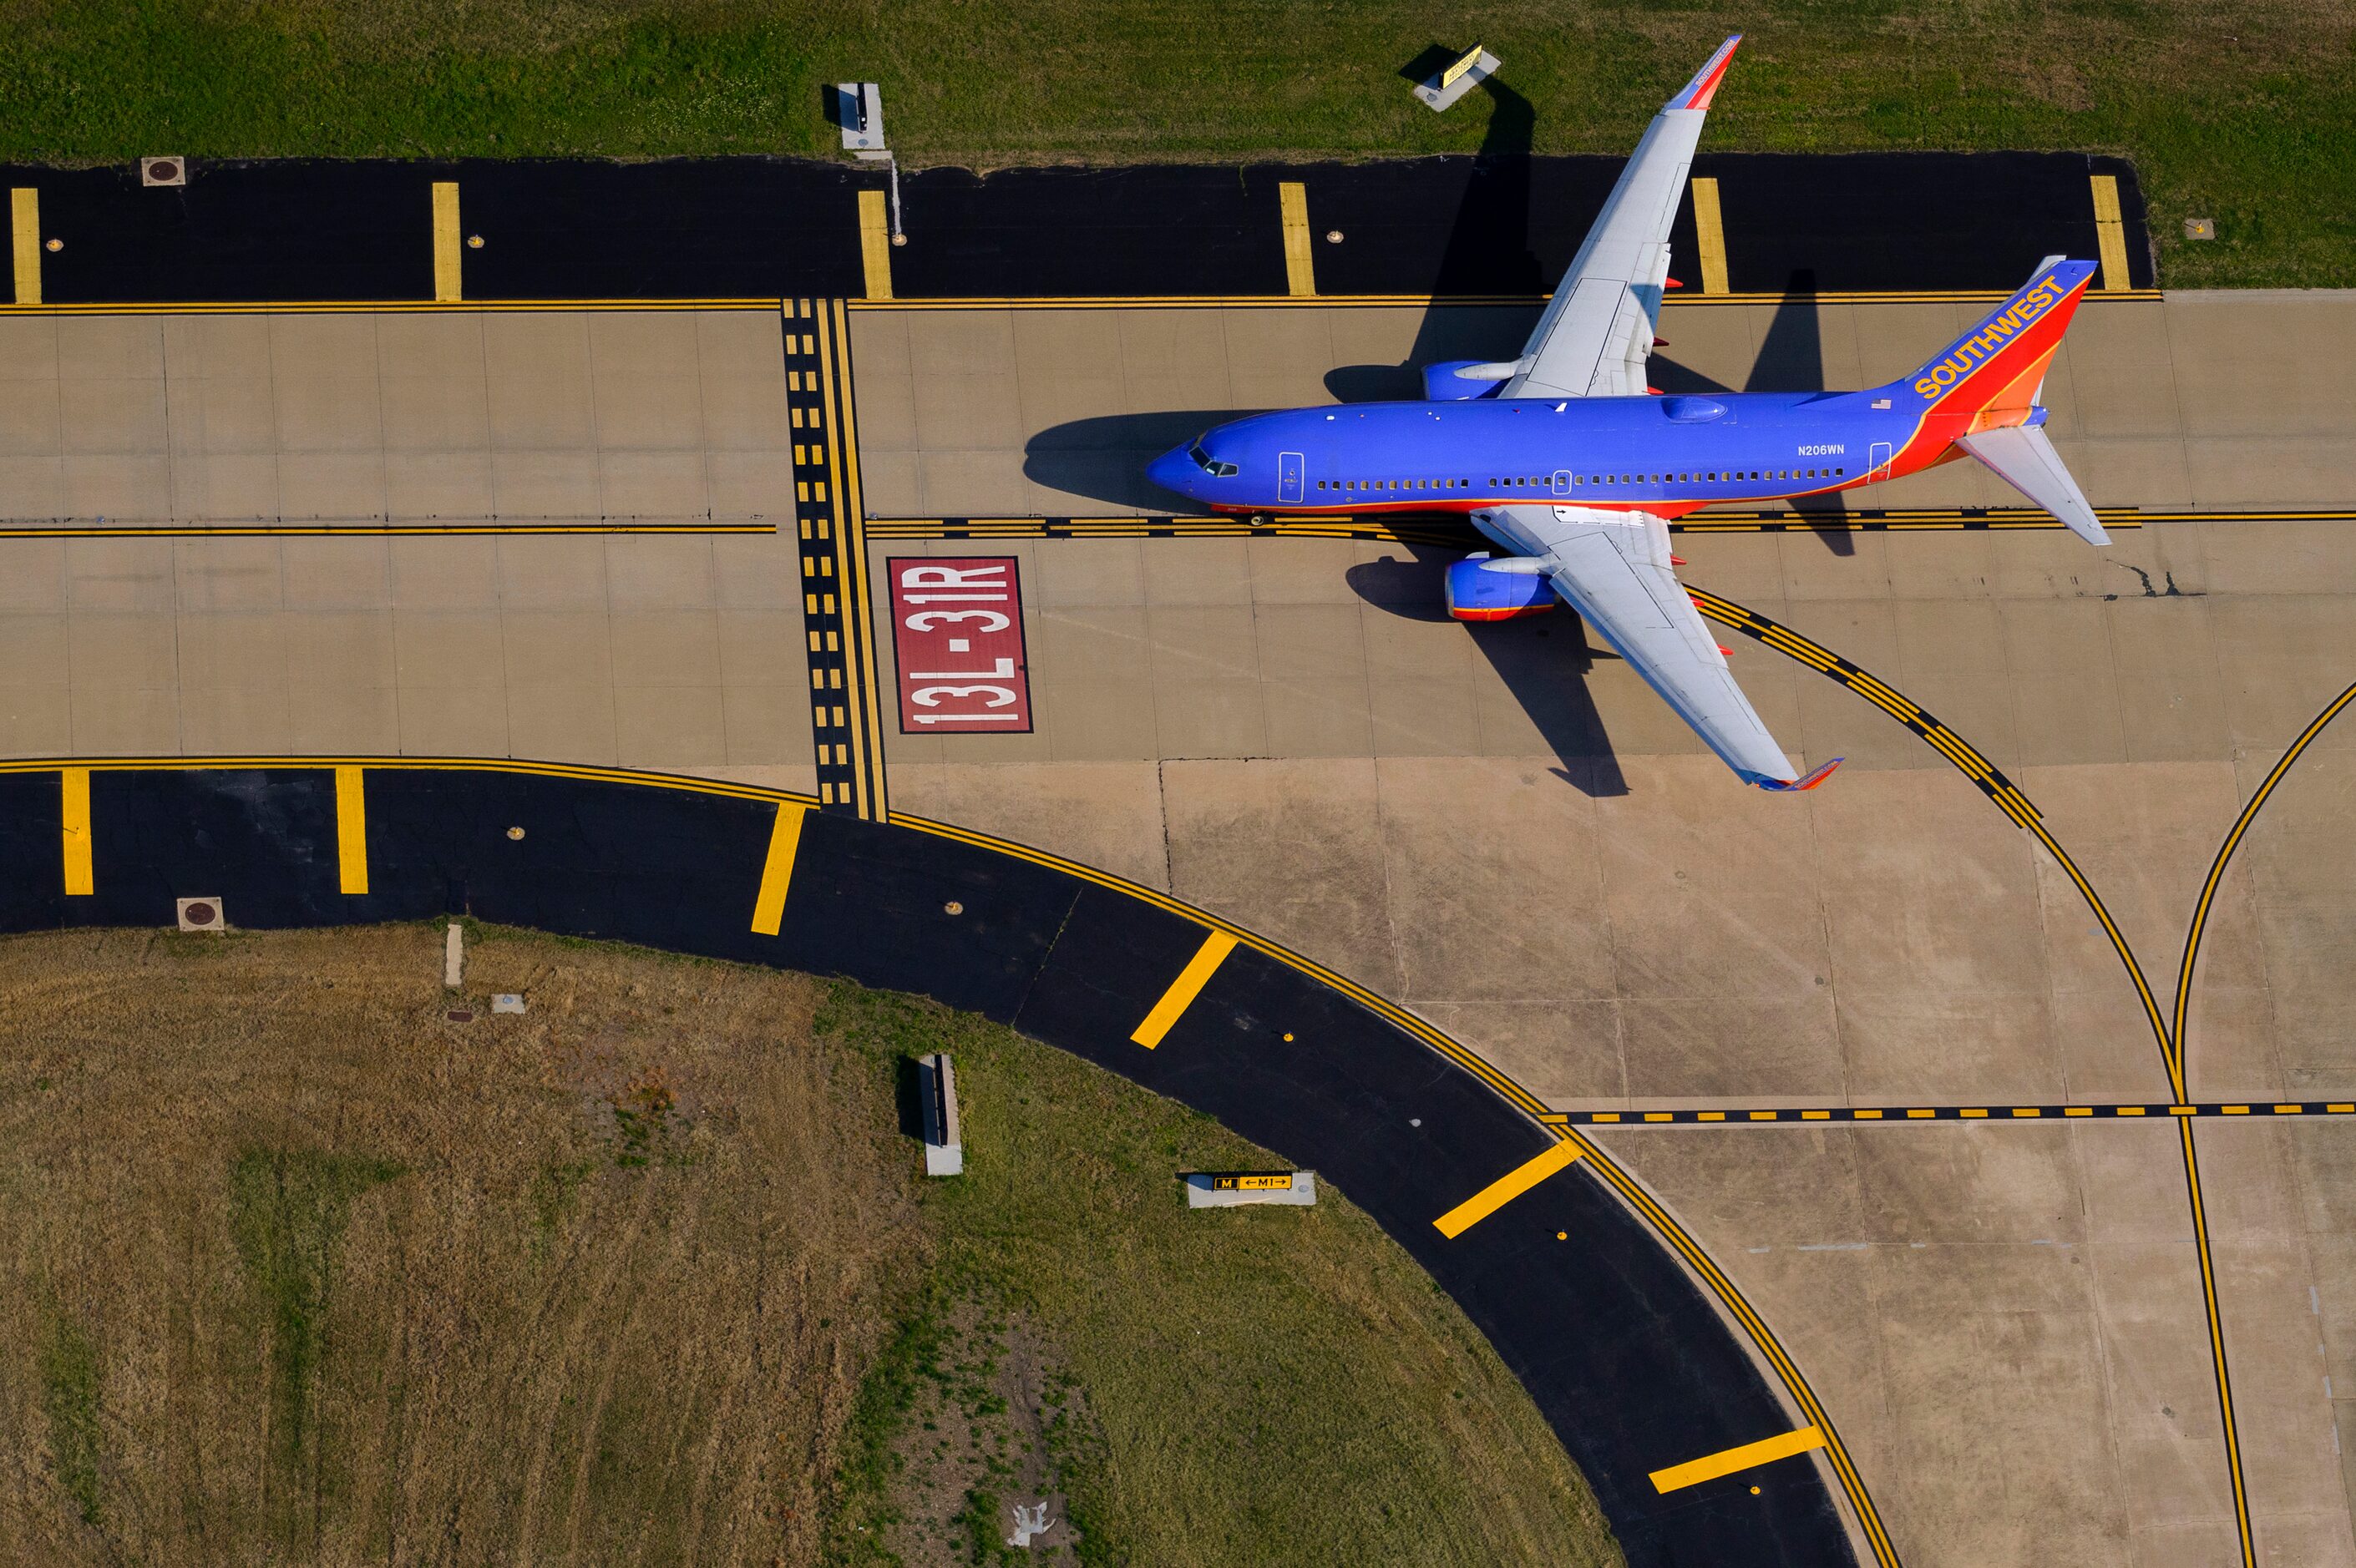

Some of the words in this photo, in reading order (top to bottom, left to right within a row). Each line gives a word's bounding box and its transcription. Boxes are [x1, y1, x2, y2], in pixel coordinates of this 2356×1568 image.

[1695, 39, 1736, 87] SOUTHWEST.COM
[1915, 276, 2064, 399] SOUTHWEST
[1798, 444, 1844, 456] N206WN
[901, 566, 1019, 725] 13L-31R
[1222, 1179, 1232, 1188] M
[1259, 1178, 1273, 1186] M1
